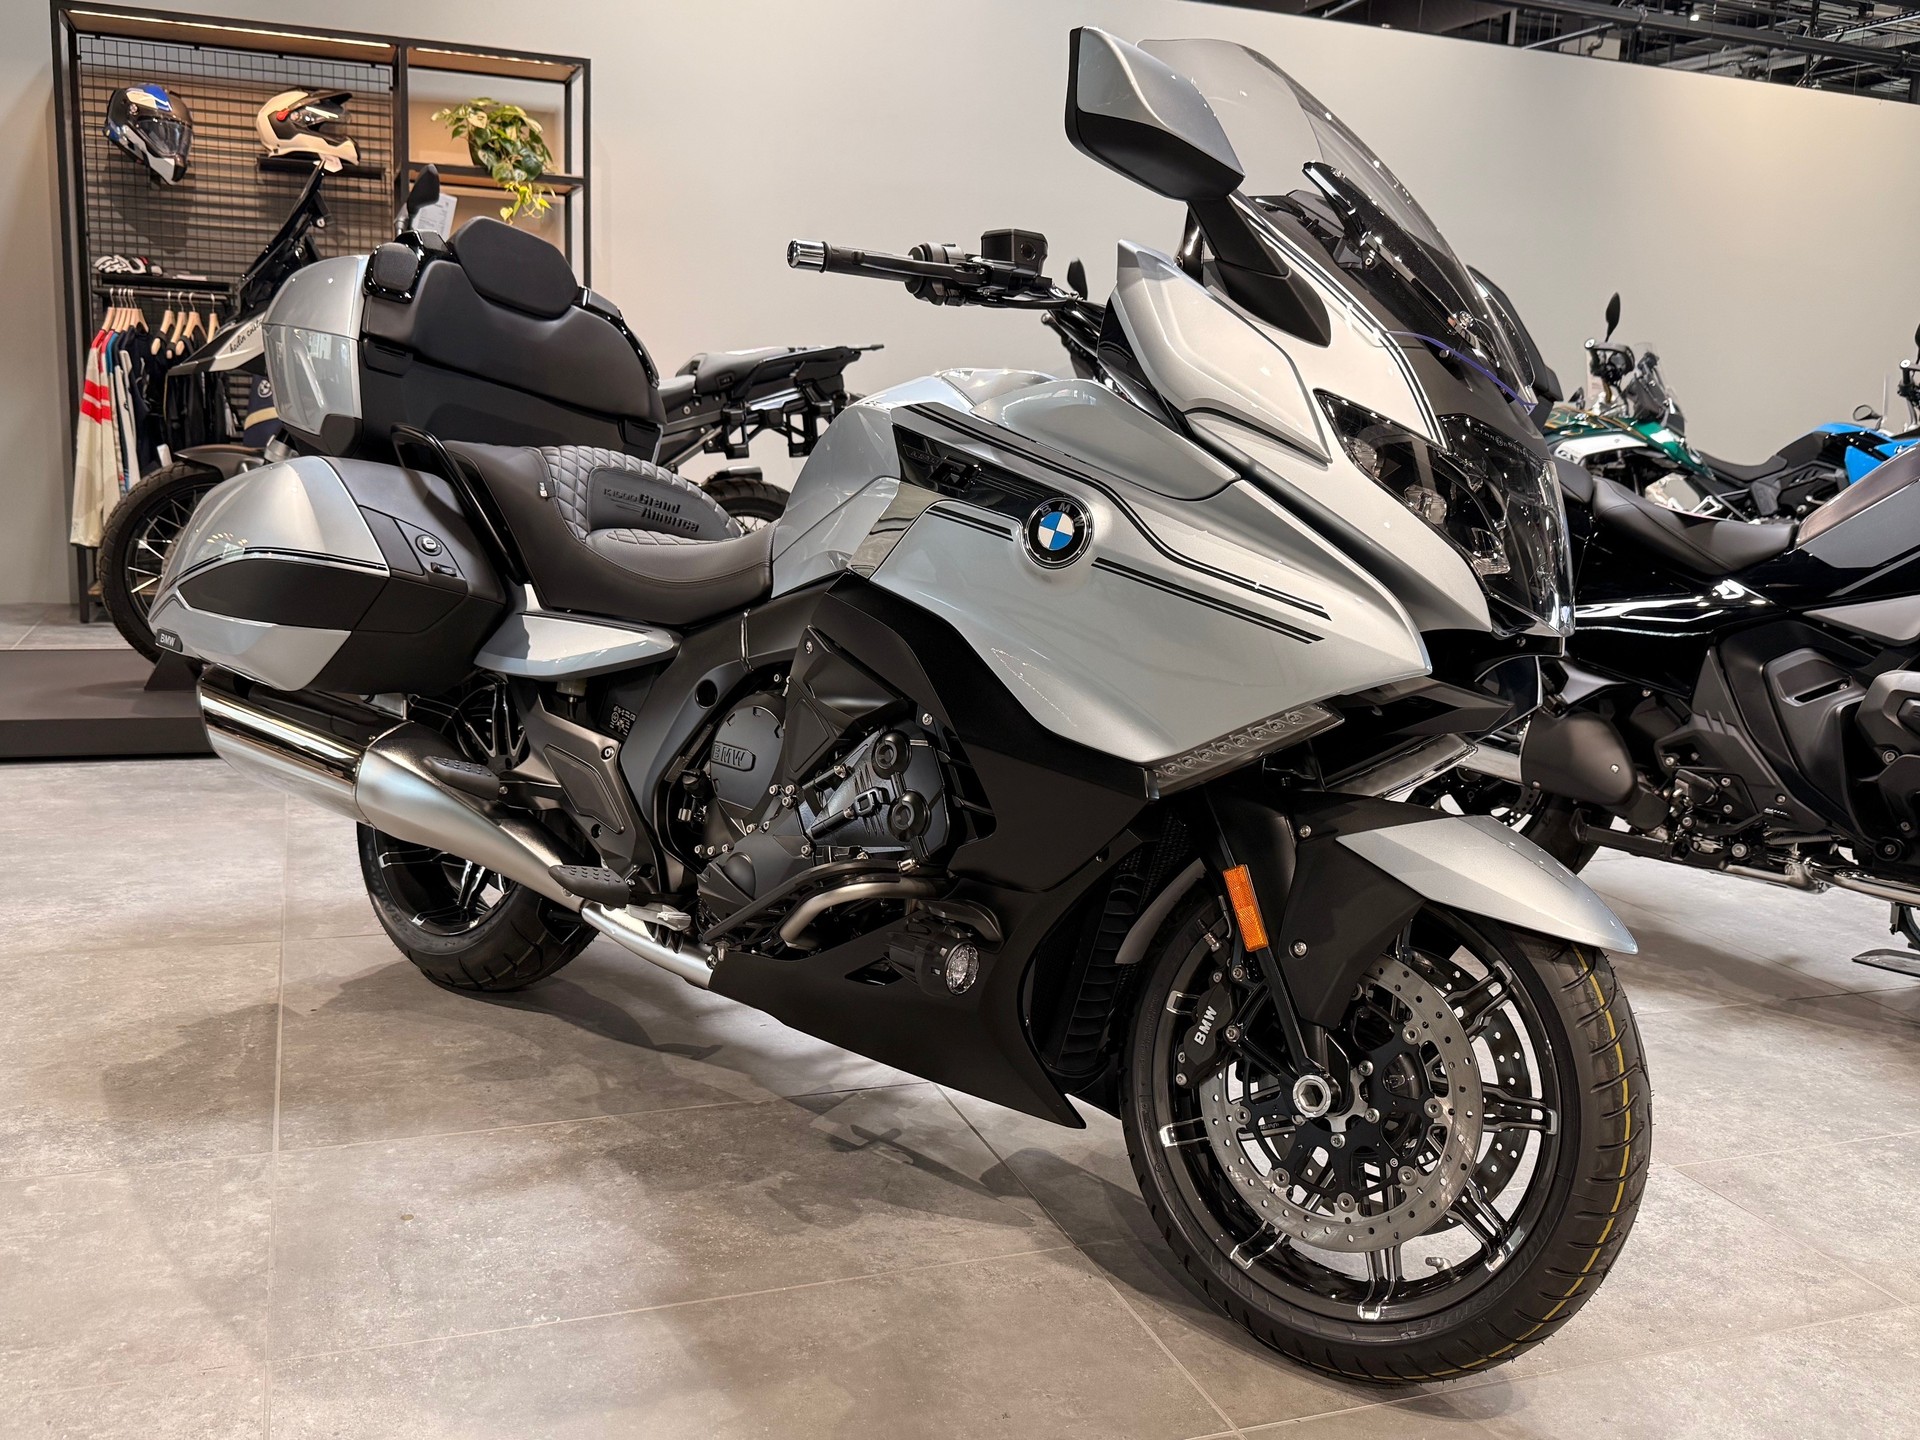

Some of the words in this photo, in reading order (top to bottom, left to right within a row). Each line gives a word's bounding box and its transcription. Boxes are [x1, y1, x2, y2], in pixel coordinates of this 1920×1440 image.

[639, 493, 681, 514] Grand
[1040, 502, 1085, 527] BMW
[641, 507, 700, 533] America
[160, 633, 176, 647] BMW
[712, 744, 746, 767] BMW
[1194, 1005, 1217, 1046] BMW
